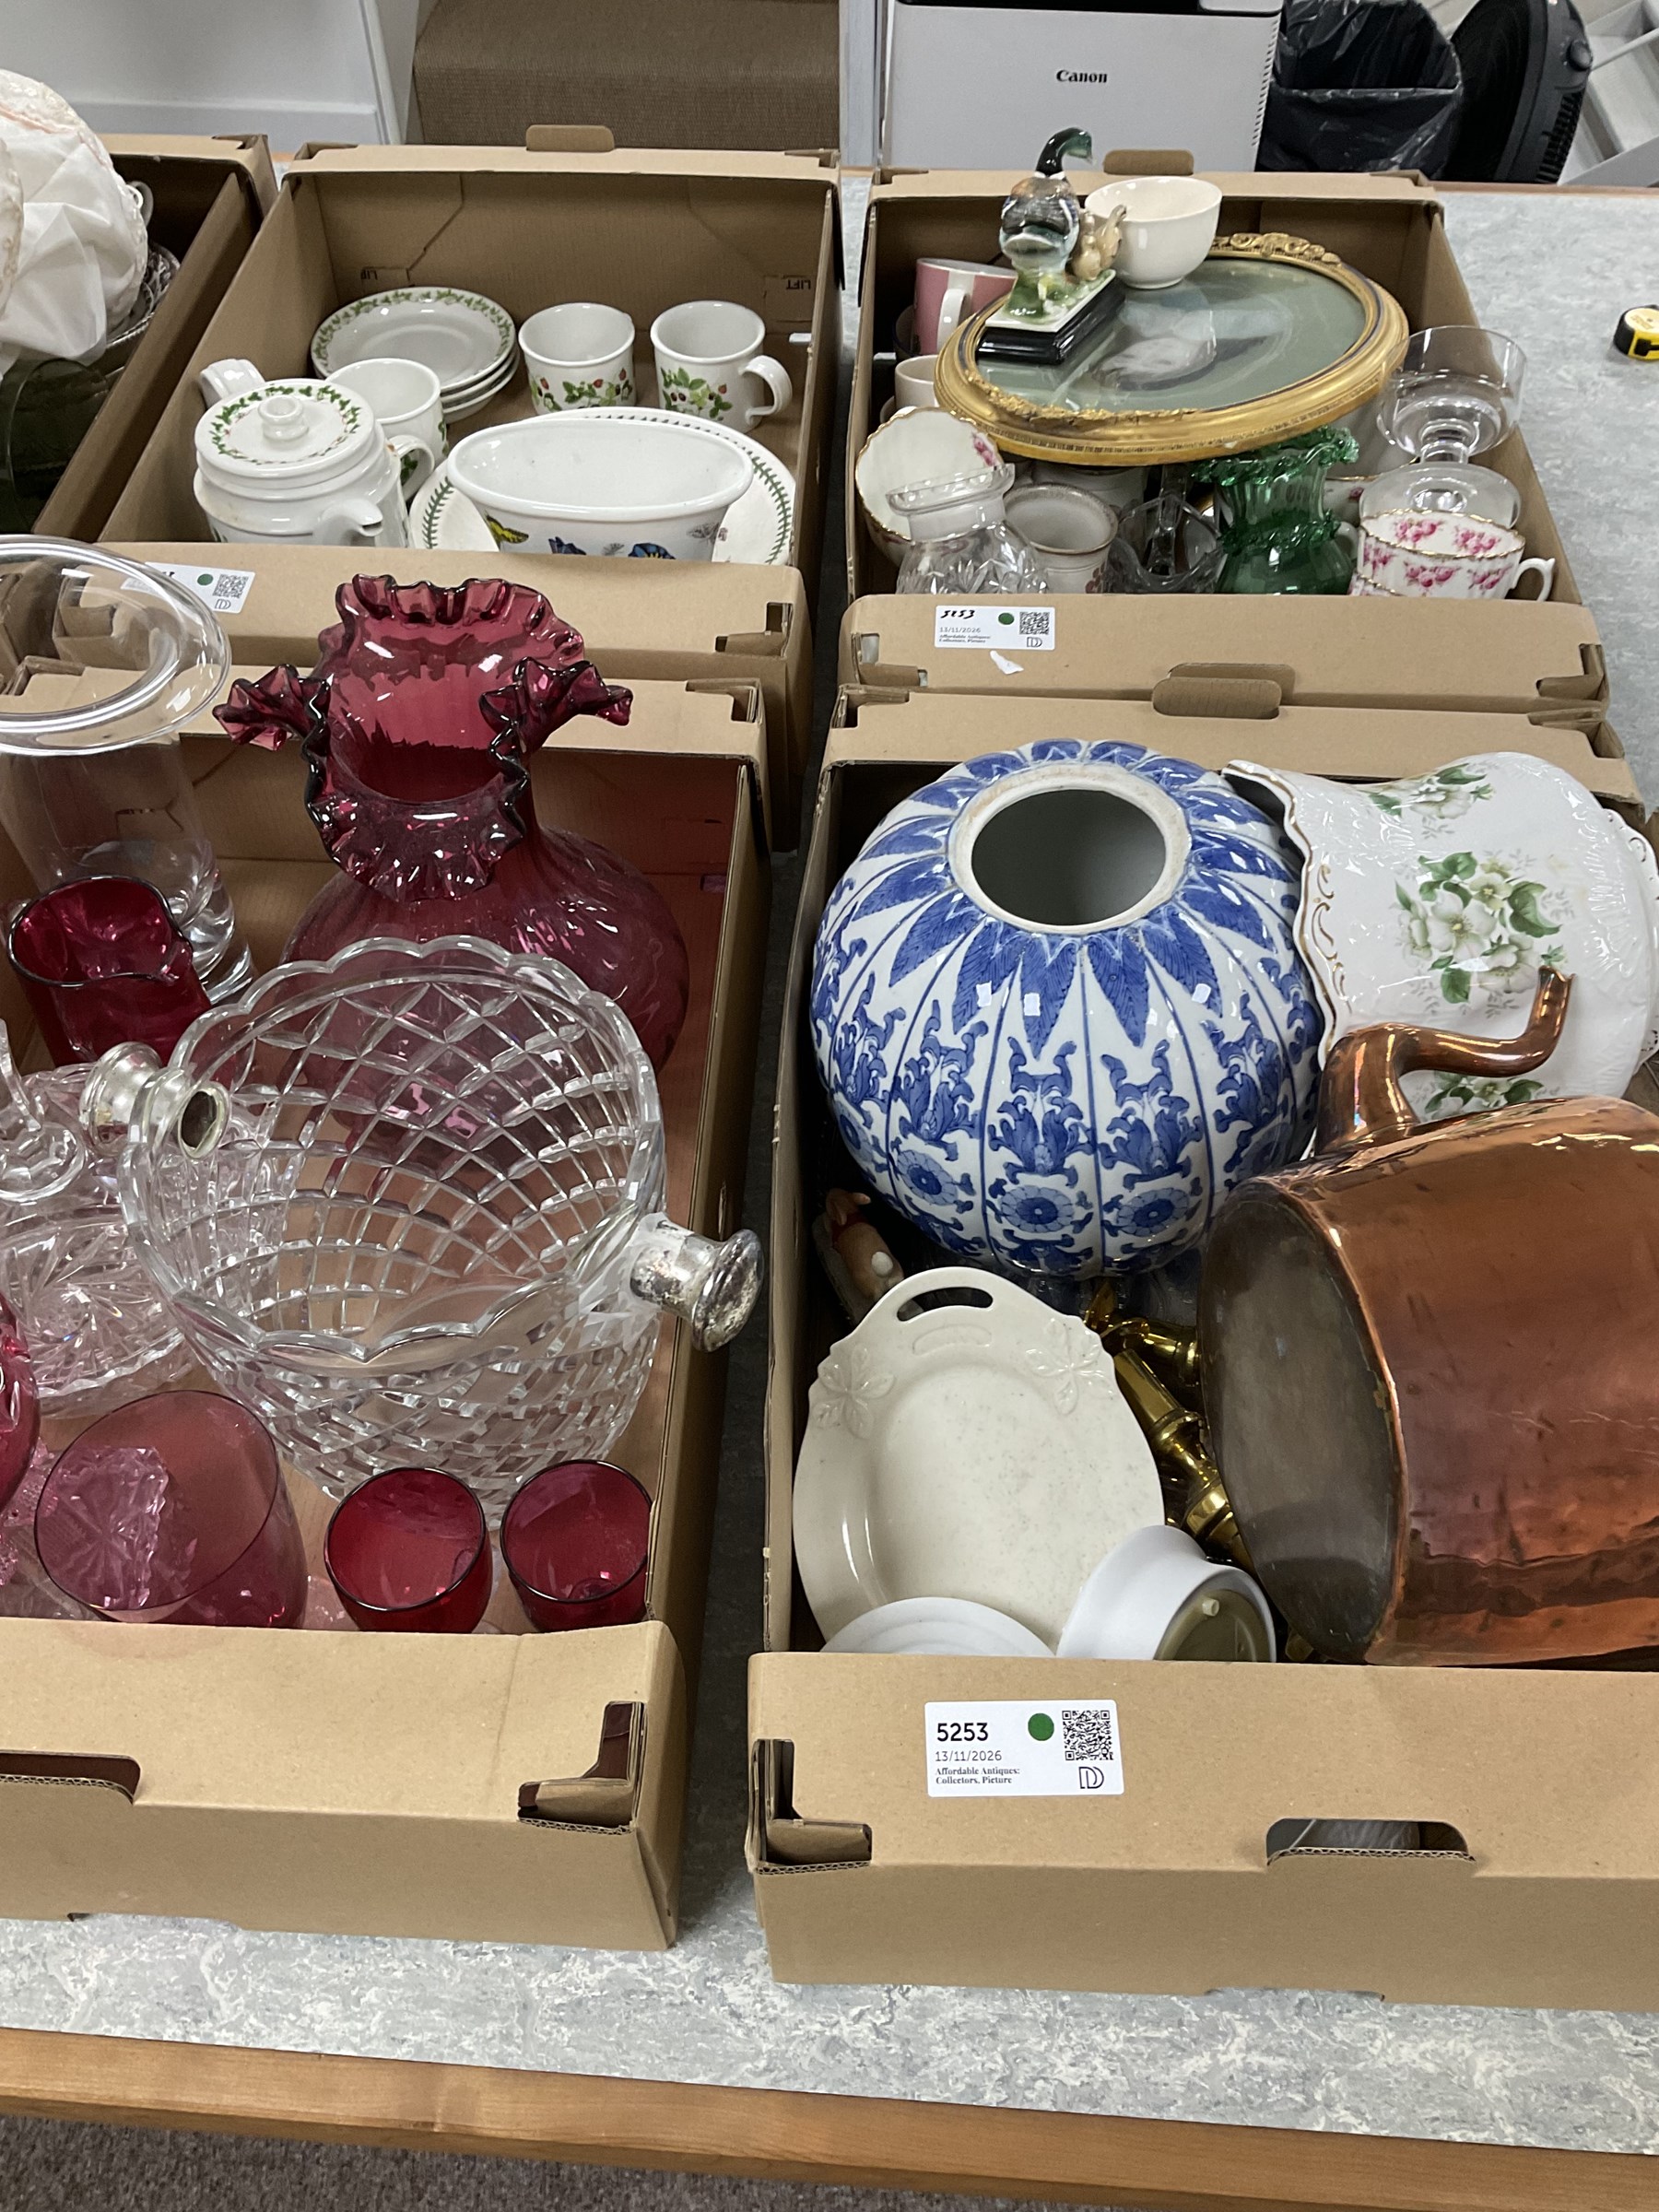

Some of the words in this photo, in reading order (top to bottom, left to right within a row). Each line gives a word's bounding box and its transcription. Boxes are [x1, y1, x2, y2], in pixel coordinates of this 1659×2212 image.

[1056, 69, 1108, 83] Canon
[786, 279, 811, 290] LIFT
[936, 1722, 989, 1742] 5253
[935, 1750, 1002, 1761] 13/11/2026
[935, 1767, 979, 1775] Affordable
[982, 1775, 1012, 1783] Picture
